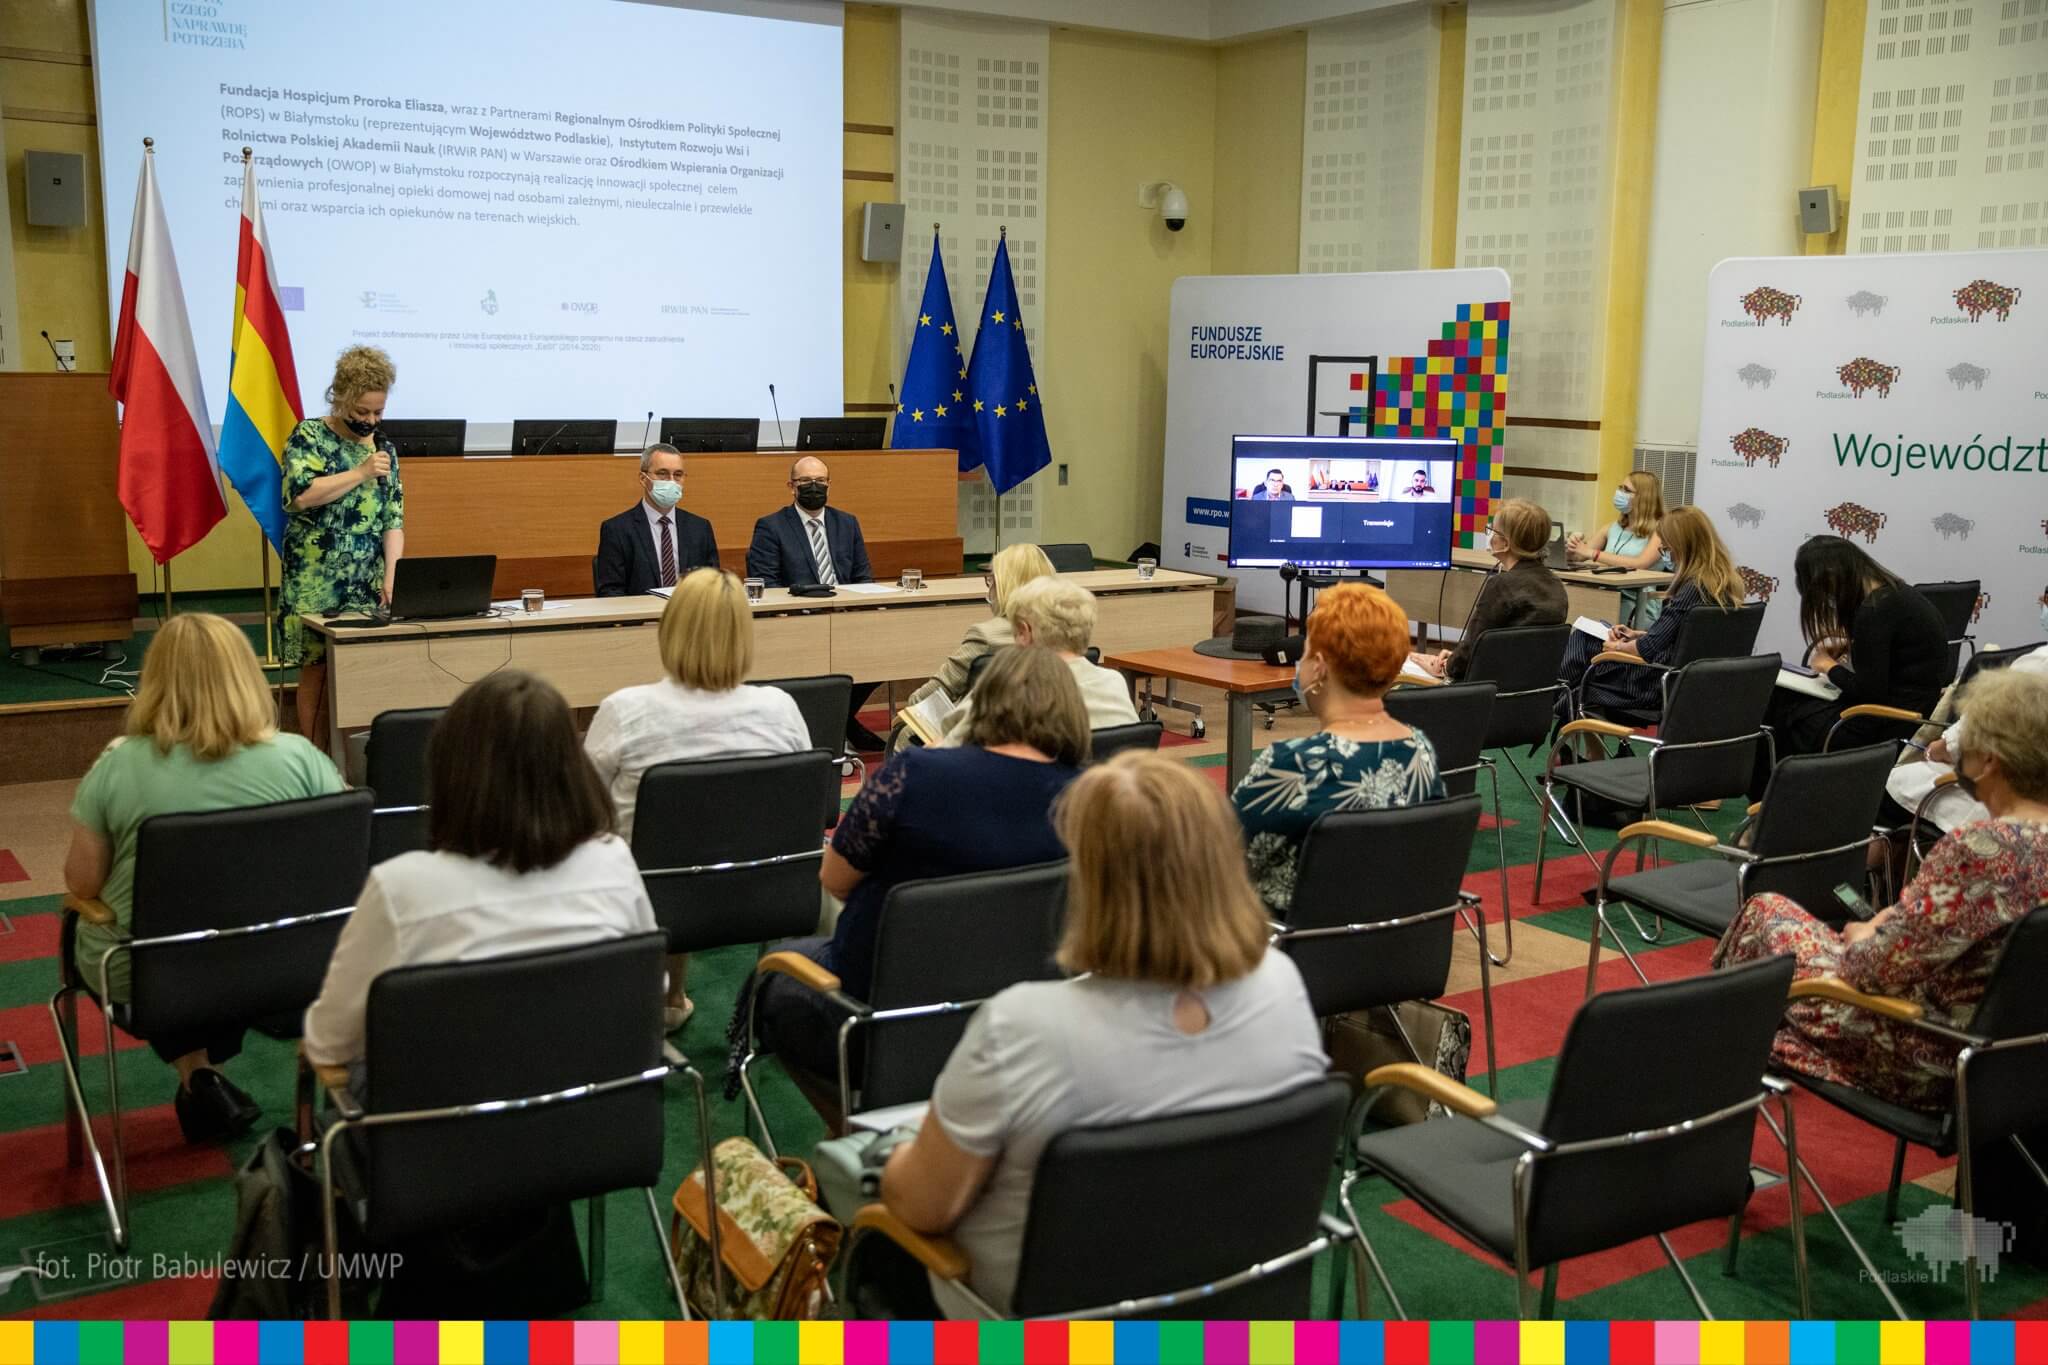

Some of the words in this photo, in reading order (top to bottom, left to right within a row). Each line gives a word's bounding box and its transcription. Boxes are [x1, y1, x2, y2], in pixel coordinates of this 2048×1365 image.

[172, 2, 217, 17] CZEGO
[173, 31, 247, 49] POTRZEBA
[220, 83, 280, 101] Fundacja
[284, 89, 350, 106] Hospicjum
[354, 95, 401, 109] Proroka
[405, 99, 448, 114] Eliasza,
[451, 105, 479, 116] wraz
[482, 107, 488, 116] z
[490, 106, 551, 121] Partnerami
[555, 112, 625, 129] Regionalnym
[628, 118, 685, 132] Ośrodkiem
[688, 123, 726, 137] Polityki
[728, 127, 781, 142] Społecznej
[221, 104, 265, 122] (ROPS)
[269, 111, 280, 121] w
[284, 110, 359, 128] Białymstoku
[363, 116, 466, 137] (reprezentującym
[469, 125, 551, 142] Województwo
[555, 132, 613, 149] Podlaskie),
[620, 136, 677, 153] Instytutem
[680, 142, 722, 157] Rozwoju
[726, 146, 744, 157] Wsi
[222, 128, 287, 144] Rolnictwa
[291, 133, 339, 150] Polskiej
[343, 137, 400, 152] Akademii
[404, 142, 436, 155] Nauk
[480, 147, 507, 162] PAN)
[511, 152, 521, 161] w
[524, 151, 581, 165] Warszawie
[584, 157, 607, 166] oraz
[610, 156, 668, 171] Ośrodkiem
[670, 161, 727, 176] Wspierania
[730, 165, 784, 182] Organizacji
[223, 151, 323, 170] Porządowych
[327, 157, 376, 175] (OWOP)
[379, 164, 390, 174] w
[394, 163, 464, 179] Białymstoku
[468, 168, 540, 186] rozpoczynają
[597, 177, 646, 192] innowacji
[649, 181, 703, 196] społecznej
[707, 183, 738, 196] celem
[224, 176, 304, 191] zapwnienia
[308, 179, 395, 197] profesjonalnej
[398, 186, 434, 200] opieki
[437, 187, 490, 204] domowej
[494, 190, 515, 203] nad
[518, 192, 565, 206] osobami
[225, 196, 277, 211] chmi
[281, 201, 308, 212] oraz
[311, 202, 365, 218] wsparcia
[368, 204, 386, 216] ich
[389, 205, 454, 222] opiekunów
[457, 209, 471, 219] na
[475, 210, 524, 224] terenach
[1191, 326, 1263, 341] FUNDUSZE
[1190, 343, 1285, 361] EUROPEJSKIE
[1833, 432, 2048, 477] Województ
[1193, 507, 1230, 519] www.rpo.w
